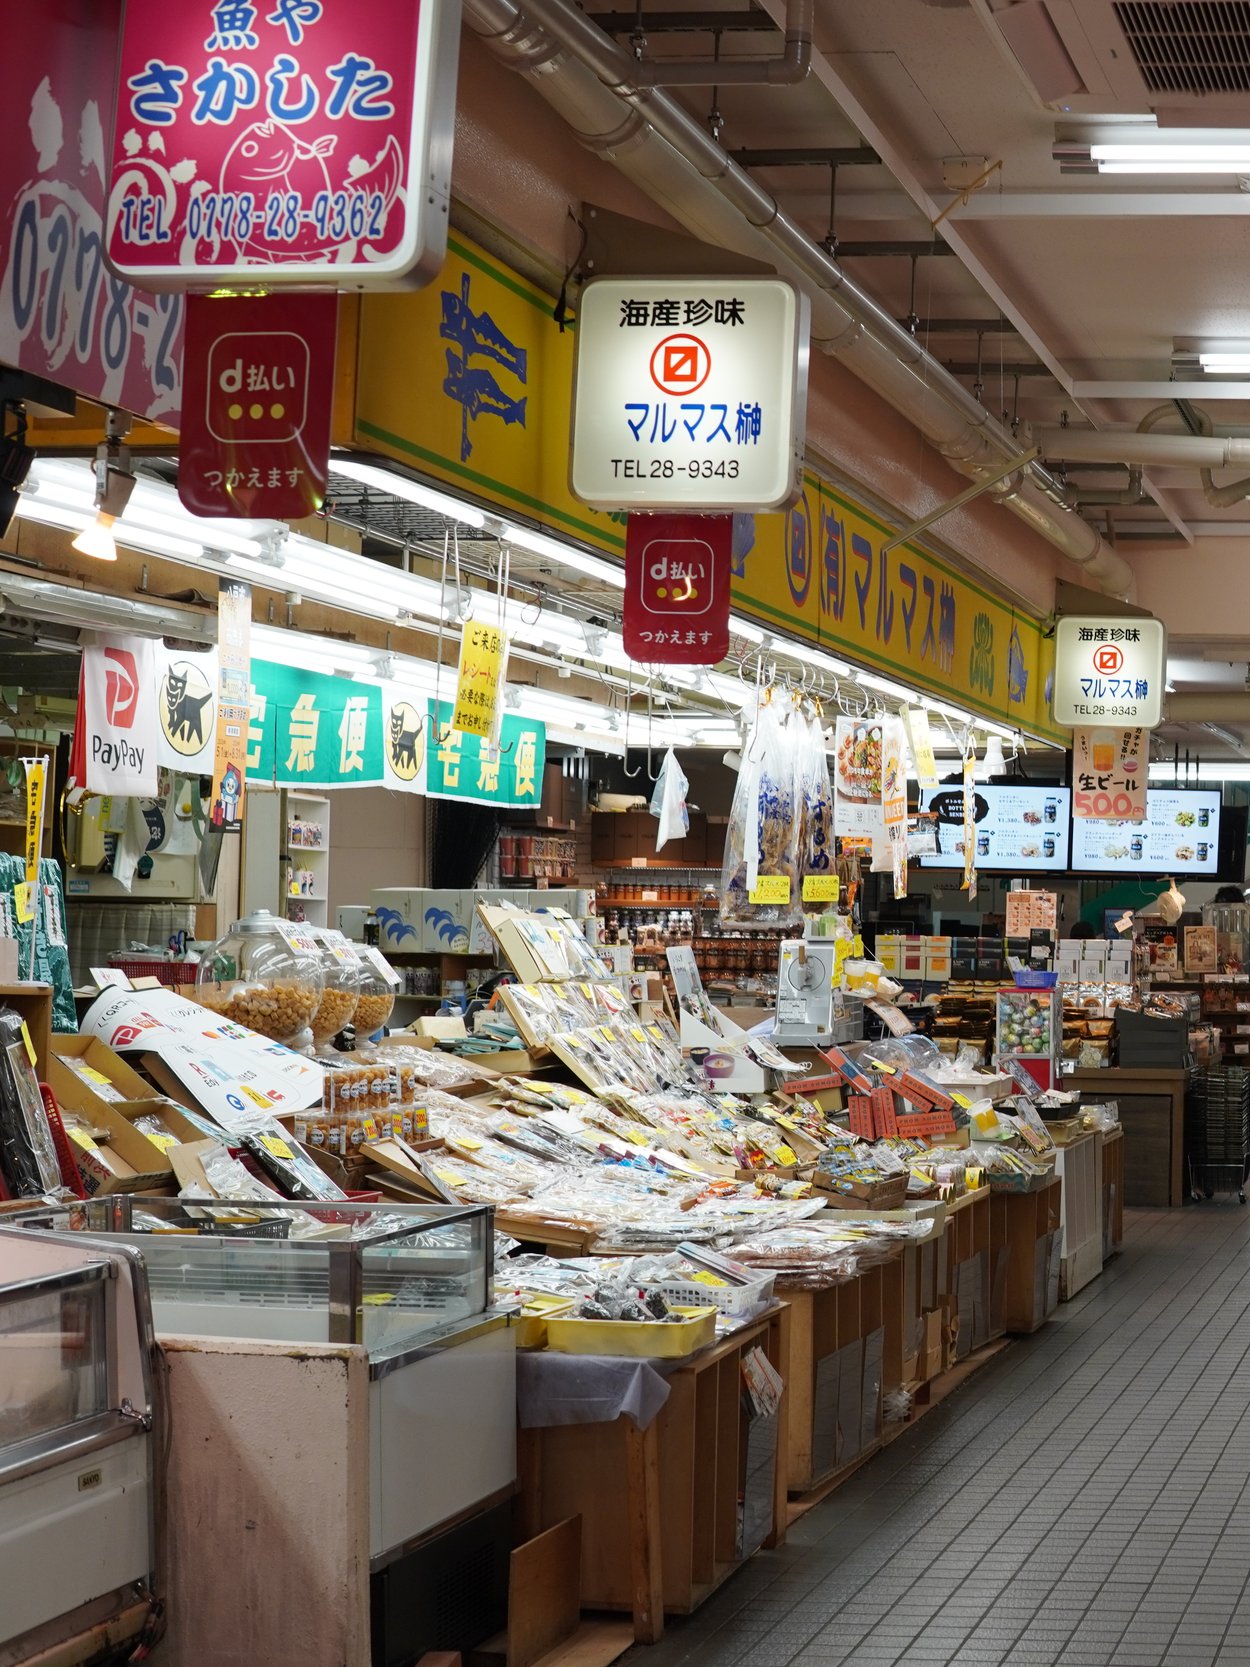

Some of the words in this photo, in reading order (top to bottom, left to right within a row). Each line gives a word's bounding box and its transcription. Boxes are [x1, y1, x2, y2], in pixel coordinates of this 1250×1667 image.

[205, 0, 321, 51] 魚や
[131, 54, 391, 122] さかした
[122, 198, 169, 240] TEL
[619, 299, 745, 327] 海産珍味
[219, 359, 296, 393] d払い
[624, 402, 762, 445] マルマス榊
[203, 467, 304, 490] つかえます
[649, 557, 705, 581] d払い
[639, 629, 713, 646] つかえます
[1078, 628, 1141, 642] 海産珍味
[1080, 678, 1148, 700] マルマス榊
[93, 734, 145, 774] PayPay
[1078, 773, 1140, 792] 生ビール
